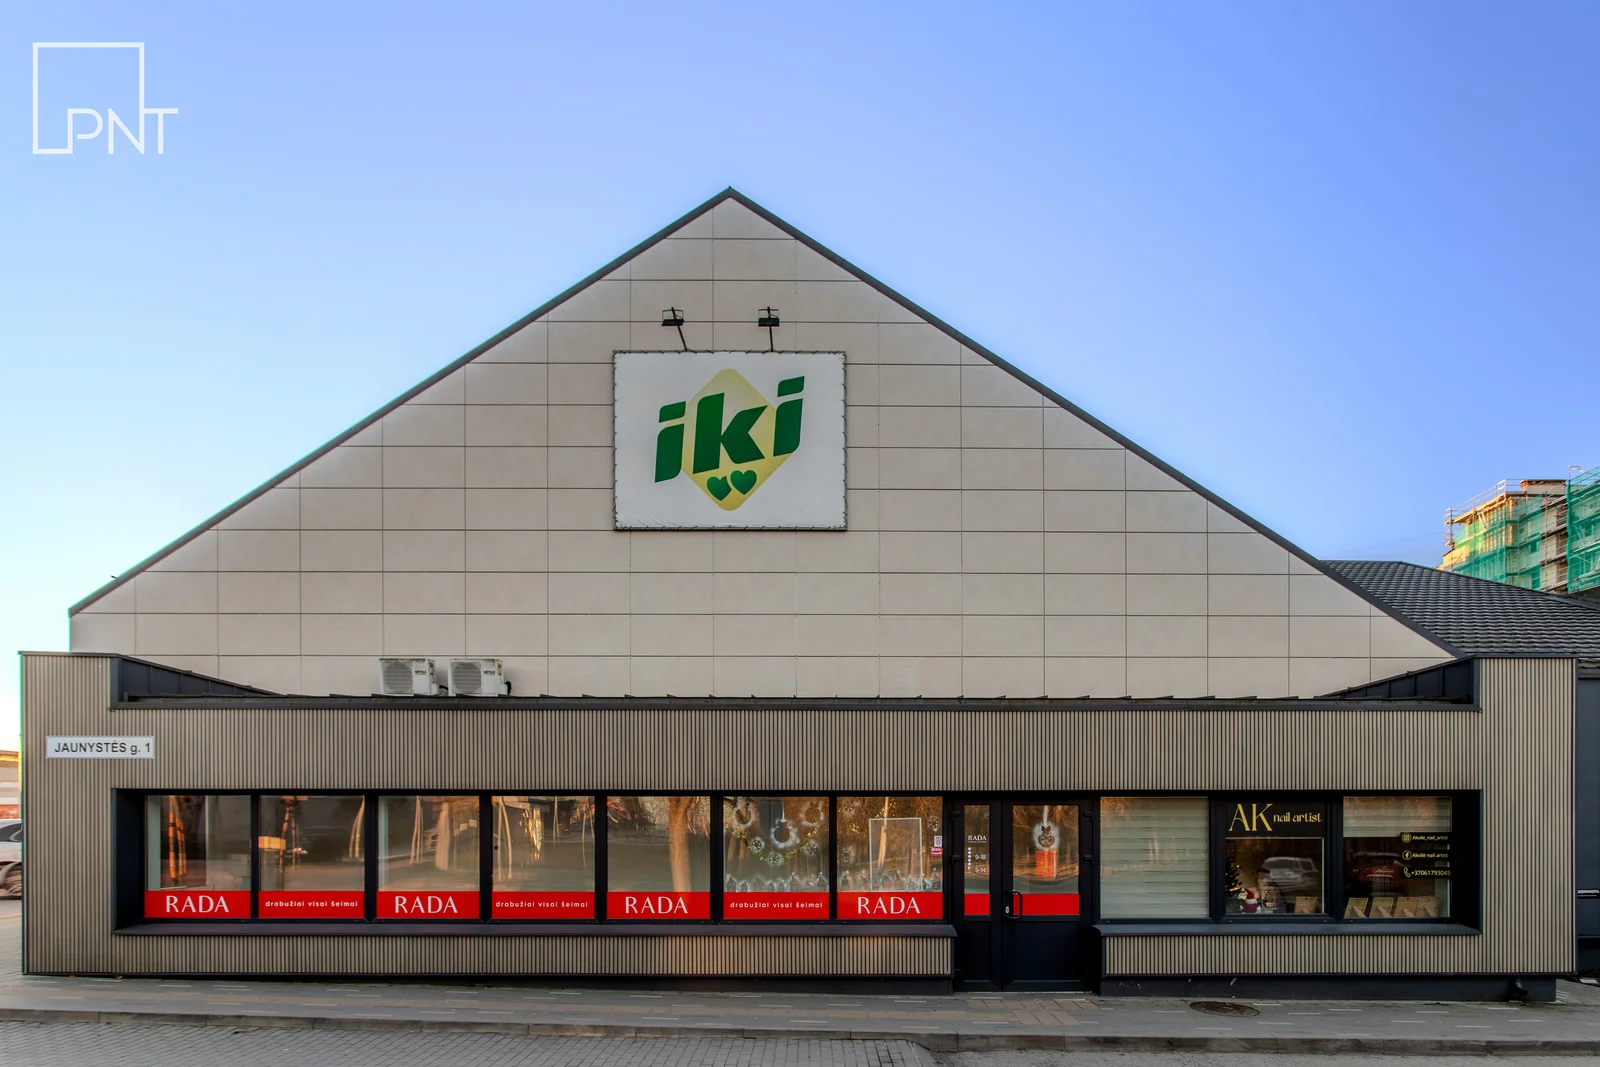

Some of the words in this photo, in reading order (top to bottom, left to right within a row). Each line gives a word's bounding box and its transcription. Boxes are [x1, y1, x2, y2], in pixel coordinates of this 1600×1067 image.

[655, 375, 805, 483] iki
[54, 740, 127, 753] JAUNYSTĖS
[130, 744, 141, 755] g.
[145, 742, 151, 753] 1
[1228, 803, 1273, 832] AK
[1273, 812, 1291, 823] nail
[1292, 812, 1322, 823] artist
[165, 895, 230, 914] RADA
[394, 895, 458, 914] RADA
[625, 896, 689, 914] RADA
[857, 896, 921, 915] RADA
